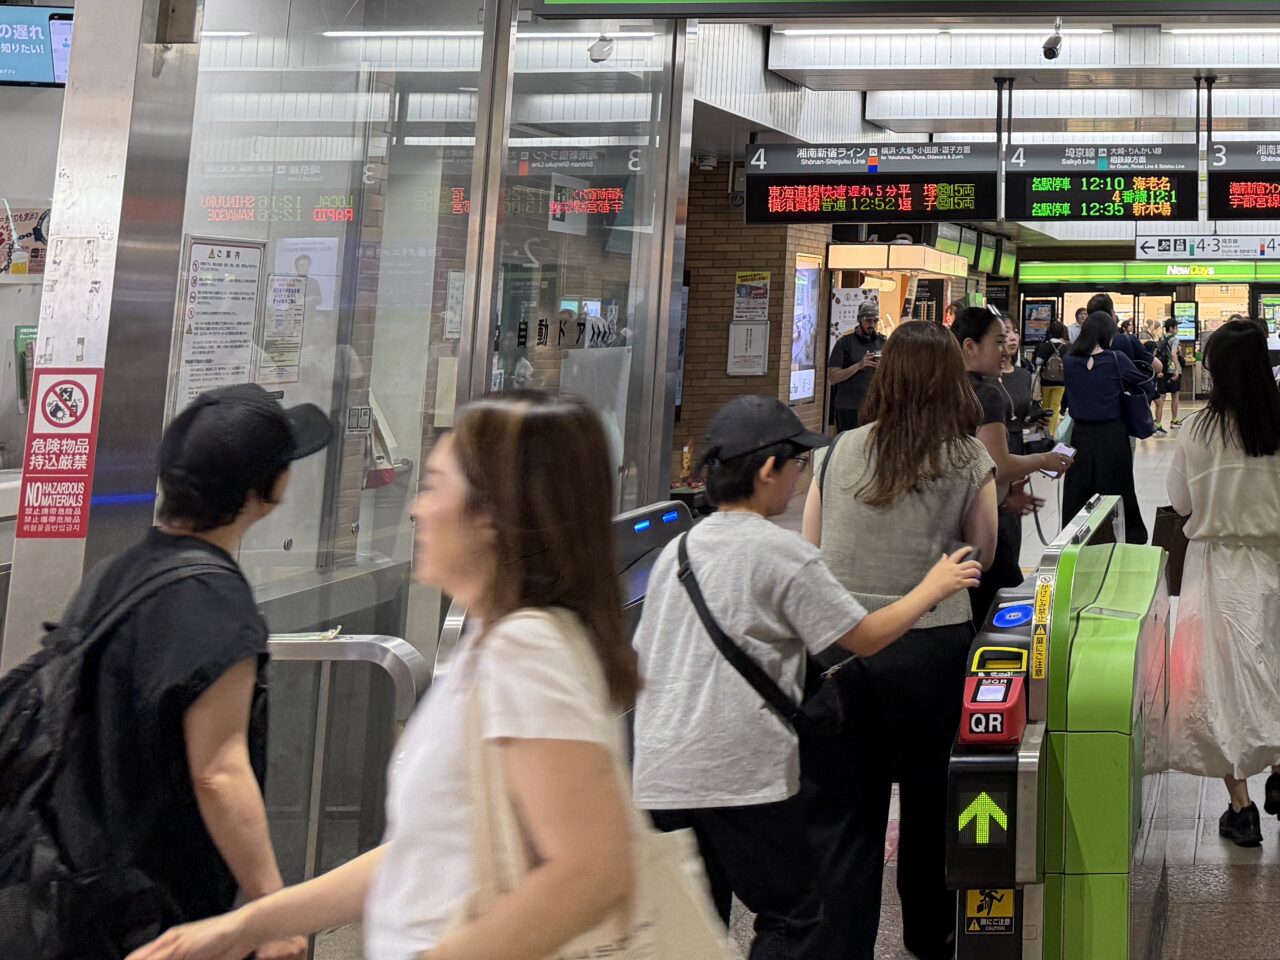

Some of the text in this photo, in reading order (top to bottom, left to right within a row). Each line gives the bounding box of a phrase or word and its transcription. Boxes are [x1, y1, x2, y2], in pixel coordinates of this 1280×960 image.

[751, 148, 767, 170] 4
[796, 147, 866, 158] 湘南新宿ライン
[1011, 147, 1026, 168] 4
[1065, 148, 1096, 158] 埼京線
[1212, 145, 1227, 167] 3
[1081, 177, 1124, 190] 12:10
[1132, 176, 1171, 191] 海老名
[851, 197, 896, 210] 12:52
[1081, 203, 1124, 215] 12:35
[1132, 202, 1172, 216] 新木場
[1167, 265, 1215, 276] NewDays
[30, 438, 90, 454] 危険物品
[29, 454, 88, 470] 持込厳禁
[25, 482, 85, 507] NO HAZARDOUS
[41, 495, 83, 507] MATERIALS
[971, 713, 1002, 733] QR
